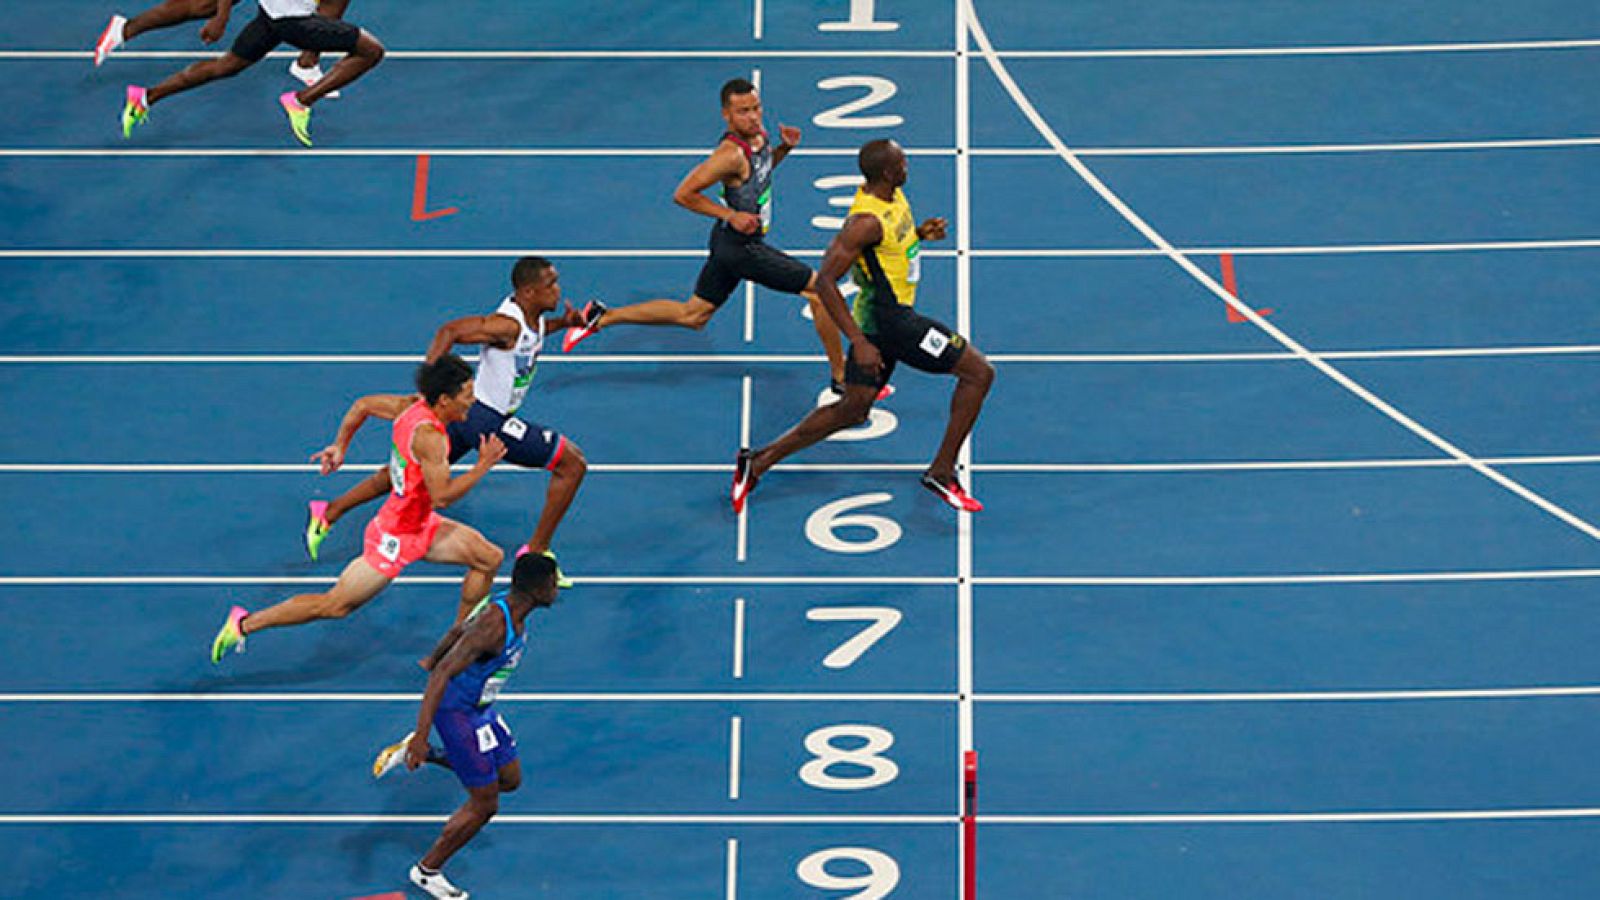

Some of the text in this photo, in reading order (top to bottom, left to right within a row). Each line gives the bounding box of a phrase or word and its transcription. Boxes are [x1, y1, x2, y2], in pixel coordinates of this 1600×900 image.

[812, 76, 904, 128] 2
[805, 492, 902, 552] 6
[806, 606, 902, 668] 7
[799, 724, 899, 790] 8
[796, 847, 901, 900] 9
